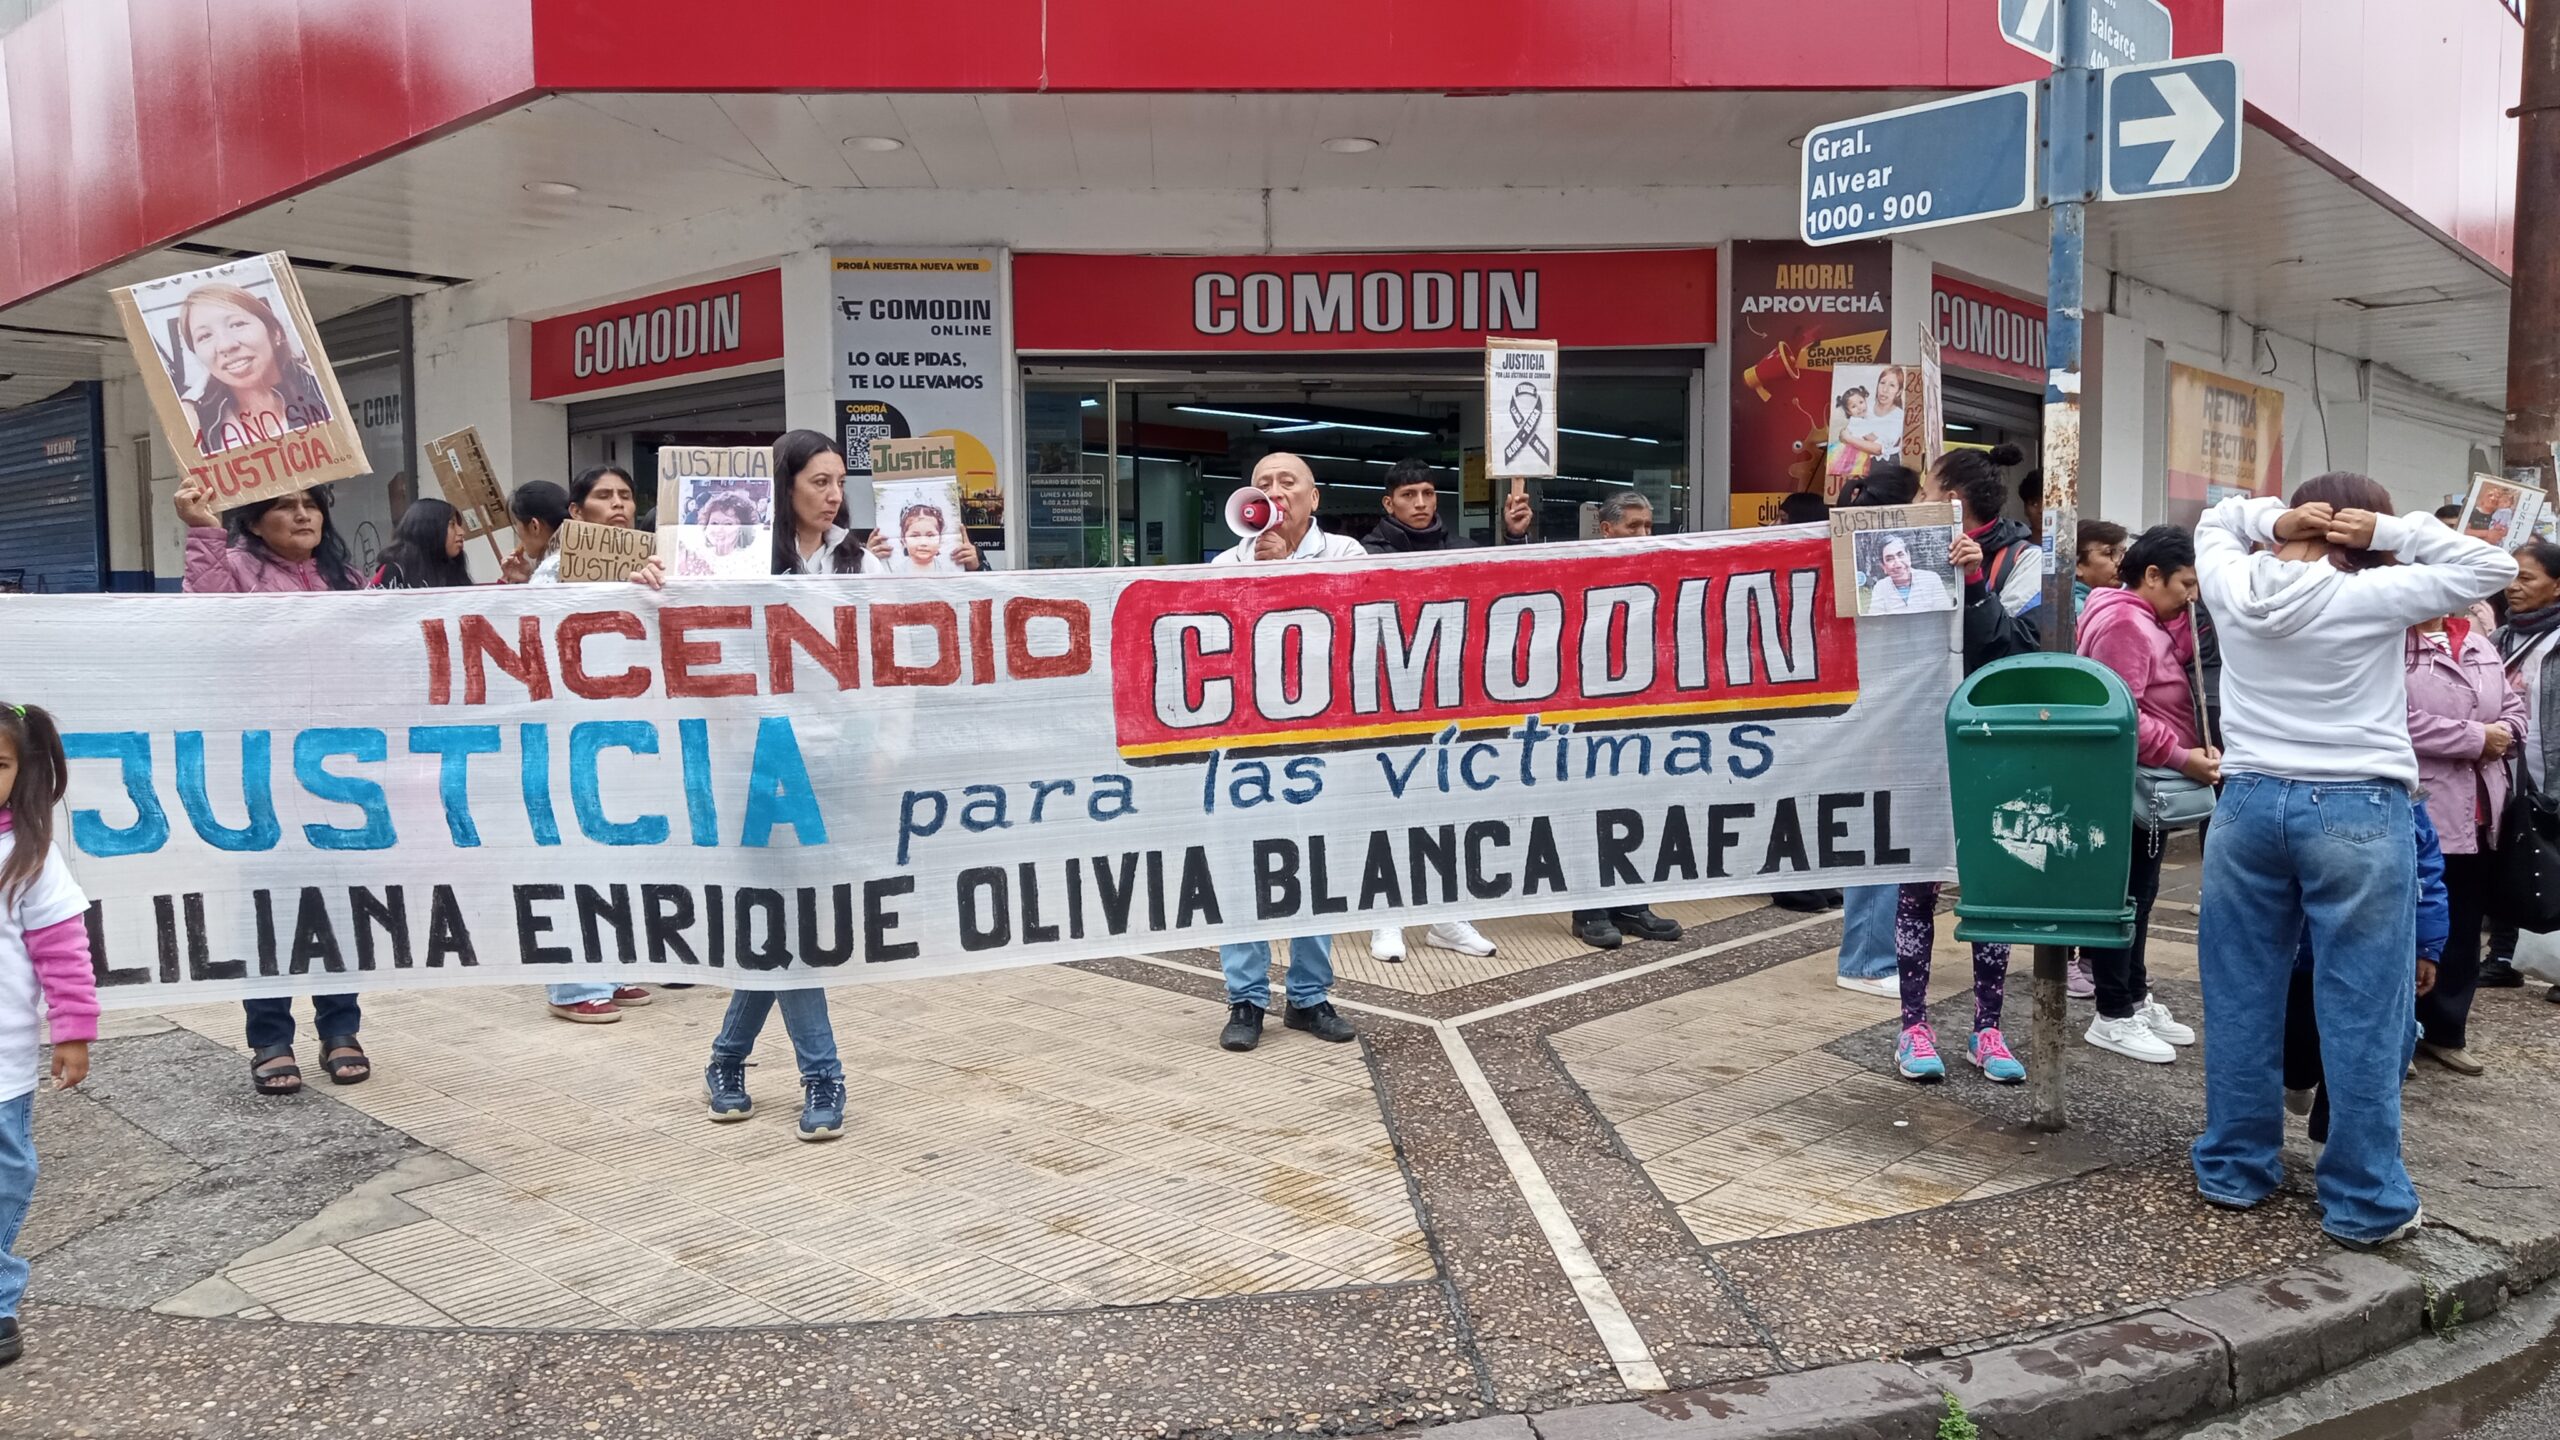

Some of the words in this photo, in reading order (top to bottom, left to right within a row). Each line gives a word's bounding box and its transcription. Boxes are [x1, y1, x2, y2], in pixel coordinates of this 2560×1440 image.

[2090, 7, 2136, 60] Balcarce
[1813, 129, 1871, 162] Gral.
[1811, 166, 1892, 200] Alvear
[1808, 203, 1863, 235] 1000
[1868, 211, 1875, 220] -
[1883, 190, 1932, 222] 900
[836, 261, 870, 271] PROBÁ
[873, 262, 918, 271] NUESTRA
[920, 262, 954, 271] NUEVA
[956, 262, 980, 271] WEB
[1776, 264, 1854, 290] AHORA!
[870, 299, 991, 321] COMODIN
[1192, 270, 1538, 335] COMODIN
[1740, 291, 1885, 313] APROVECHÁ
[573, 292, 741, 380] COMODIN
[931, 325, 992, 336] ONLINE
[1932, 290, 2047, 370] COMODIN
[848, 352, 870, 367] LO
[875, 352, 910, 367] QUE
[914, 352, 967, 368] PIDAS,
[1502, 353, 1545, 371] JUSTICIA
[1807, 344, 1872, 359] GRANDES
[1807, 355, 1873, 368] BENEFICIOS
[849, 375, 868, 389] TE
[873, 375, 895, 389] LO
[900, 374, 984, 389] LLEVAMOS
[846, 403, 888, 414] COMPRÁ
[850, 414, 885, 423] AHORA
[2203, 385, 2258, 430] RETIRÁ
[193, 429, 215, 460] 1
[221, 411, 284, 454] AÑO
[285, 396, 332, 440] SIN
[1903, 436, 1921, 456] 25
[2201, 430, 2258, 464] EFECTIVO
[662, 449, 768, 481] JUSTICIA
[565, 521, 597, 550] UN
[599, 527, 634, 556] AÑO
[1832, 509, 1907, 537] JUSTICIA
[421, 596, 1092, 706] INCENDIO
[1151, 568, 1820, 730] COMODIN
[61, 716, 830, 858] JUSTICIA
[897, 771, 1139, 866] para
[1203, 748, 1326, 816] las
[1376, 714, 1778, 799] víctimas
[84, 883, 480, 987] LILIANA
[512, 875, 920, 971] ENRIQUE
[956, 844, 1223, 953] OLIVIA
[1252, 815, 1567, 920] BLANCA
[1596, 790, 1911, 888] RAFAEL
